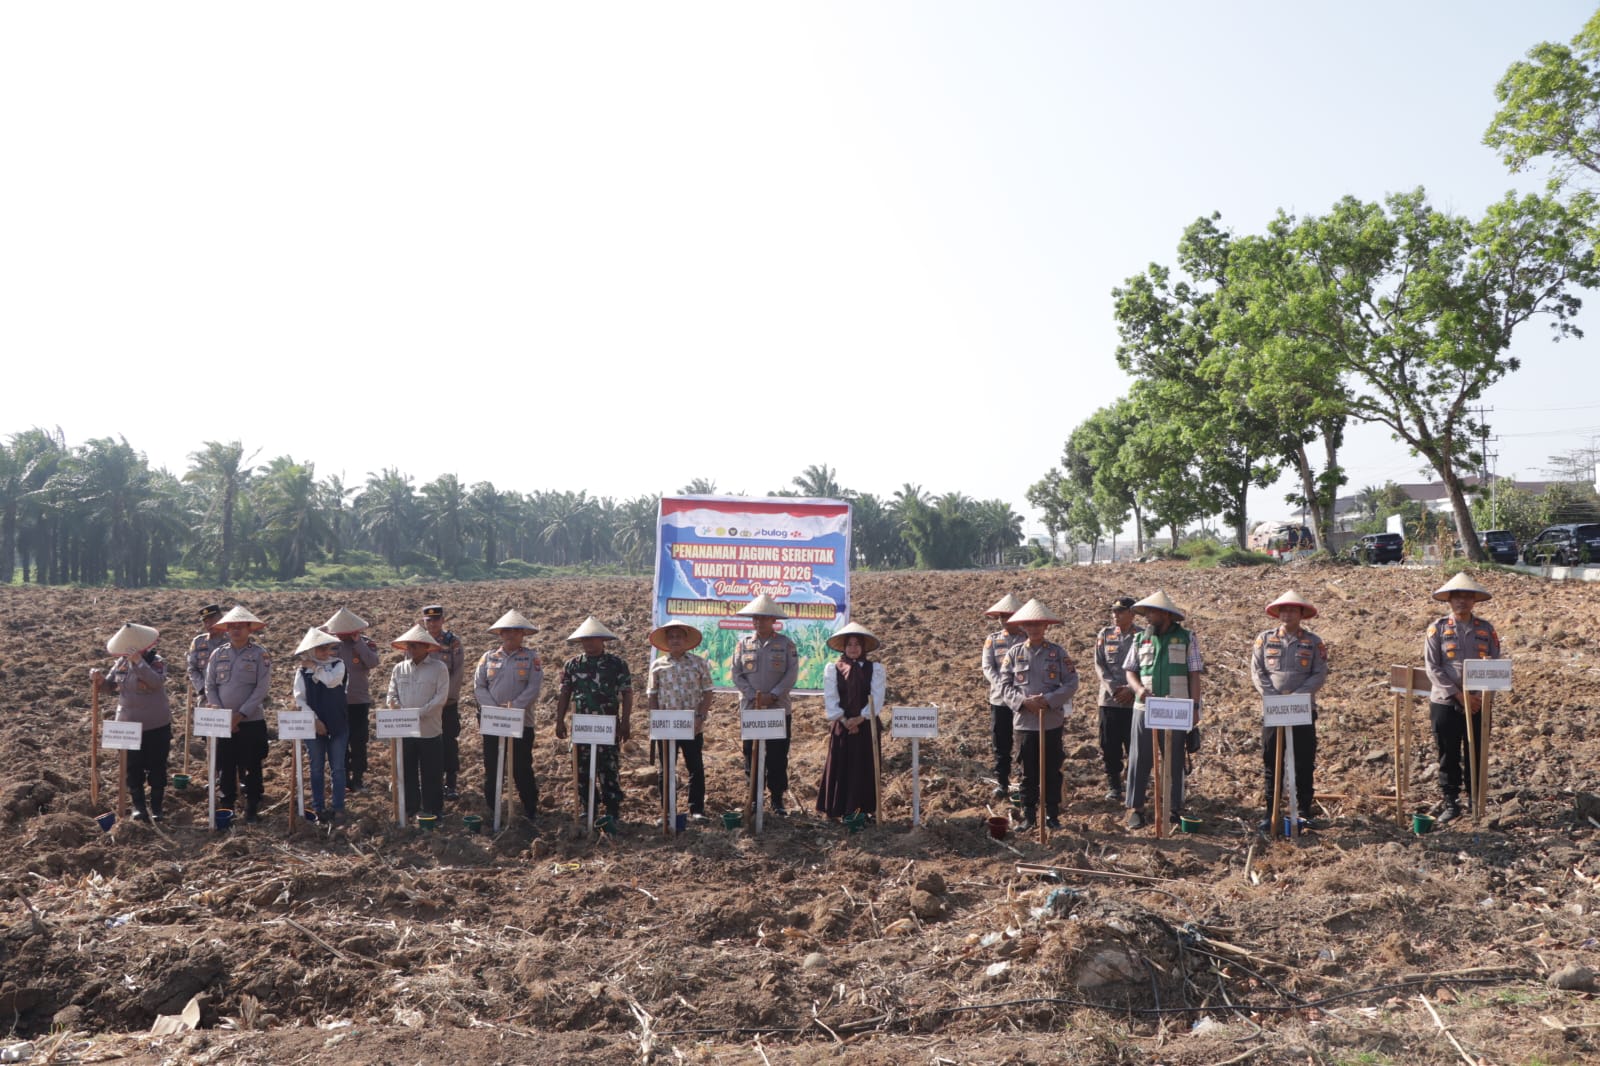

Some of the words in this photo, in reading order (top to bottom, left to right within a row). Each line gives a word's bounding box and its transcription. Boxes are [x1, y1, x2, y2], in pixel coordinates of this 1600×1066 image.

[761, 527, 788, 539] bulog
[672, 543, 737, 560] PENANAMAN
[738, 546, 780, 561] JAGUNG
[781, 547, 834, 563] SERENTAK
[694, 562, 739, 578] KUARTIL
[740, 563, 745, 578] I
[746, 564, 781, 580] TAHUN
[782, 565, 812, 581] 2026
[714, 579, 749, 596] Dalam
[750, 581, 789, 599] Rangka
[667, 600, 728, 616] MENDUKUNG
[798, 604, 835, 619] JAGUNG
[1266, 705, 1290, 714] KAPOLSEK
[652, 720, 671, 728] BUPATI
[673, 720, 692, 728] SERGAI
[743, 720, 766, 728] KAPOLRES
[767, 719, 784, 727] SERGAI
